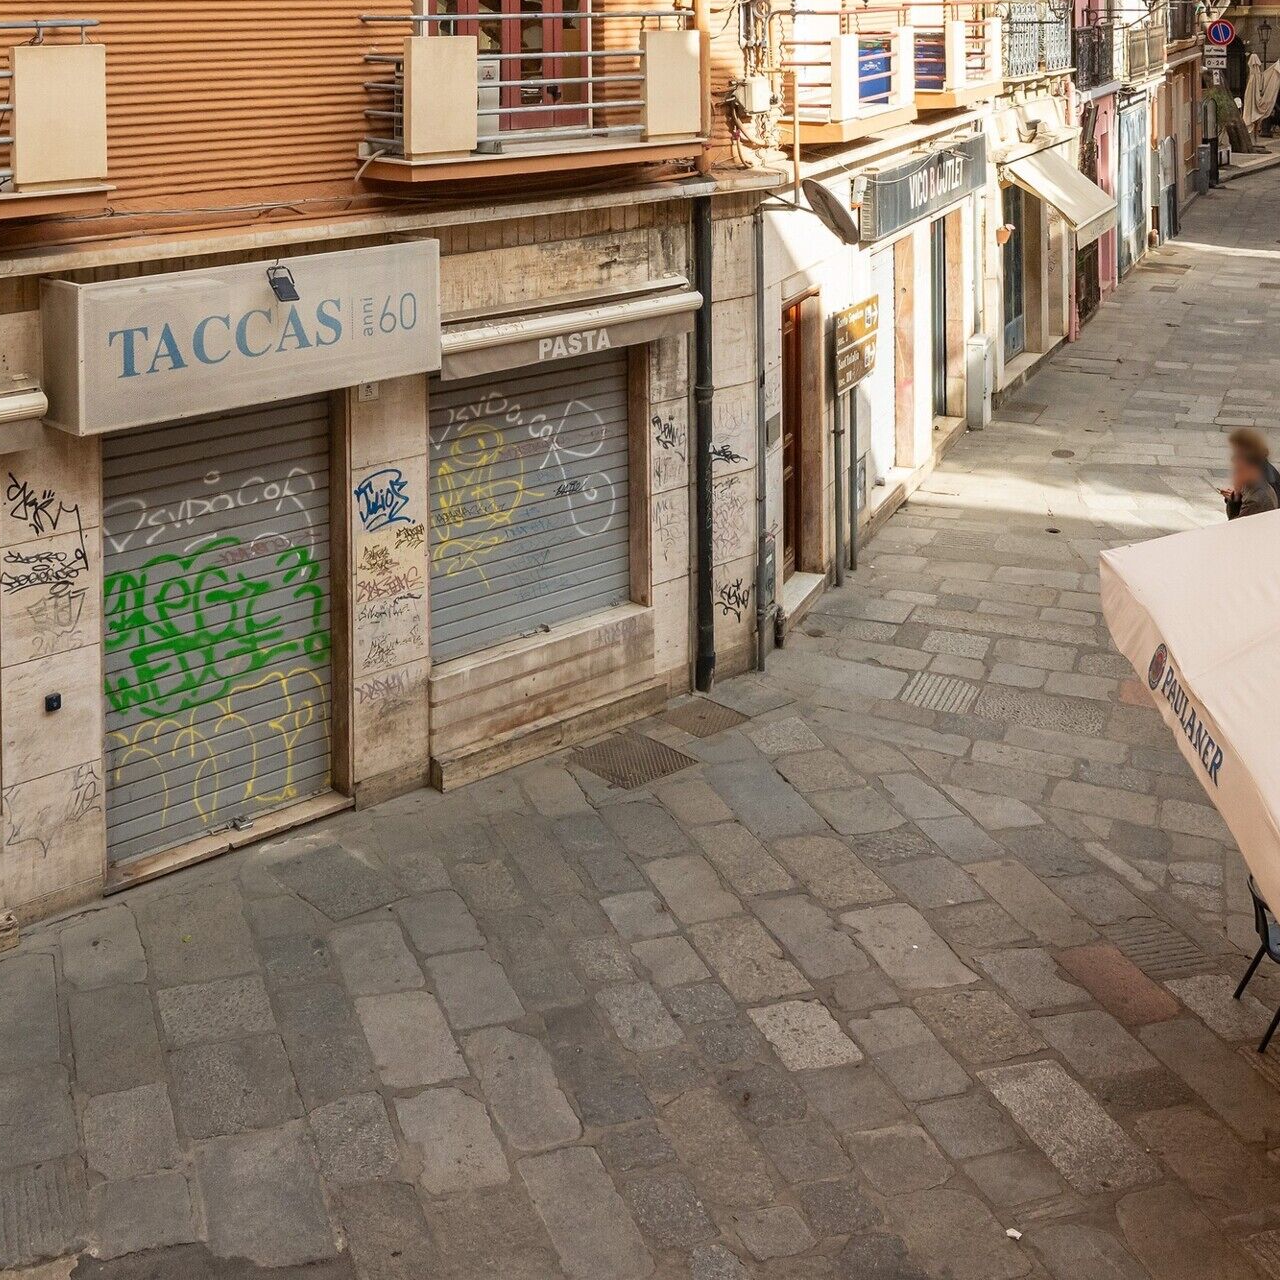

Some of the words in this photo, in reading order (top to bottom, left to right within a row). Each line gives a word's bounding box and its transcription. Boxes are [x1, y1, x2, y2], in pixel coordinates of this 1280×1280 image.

[909, 169, 928, 210] VICO
[936, 156, 964, 196] OUTLET
[360, 297, 373, 337] anni
[378, 292, 417, 333] 60
[108, 296, 343, 379] TACCAS
[538, 328, 612, 360] PASTA
[1161, 665, 1224, 790] PAULANER
